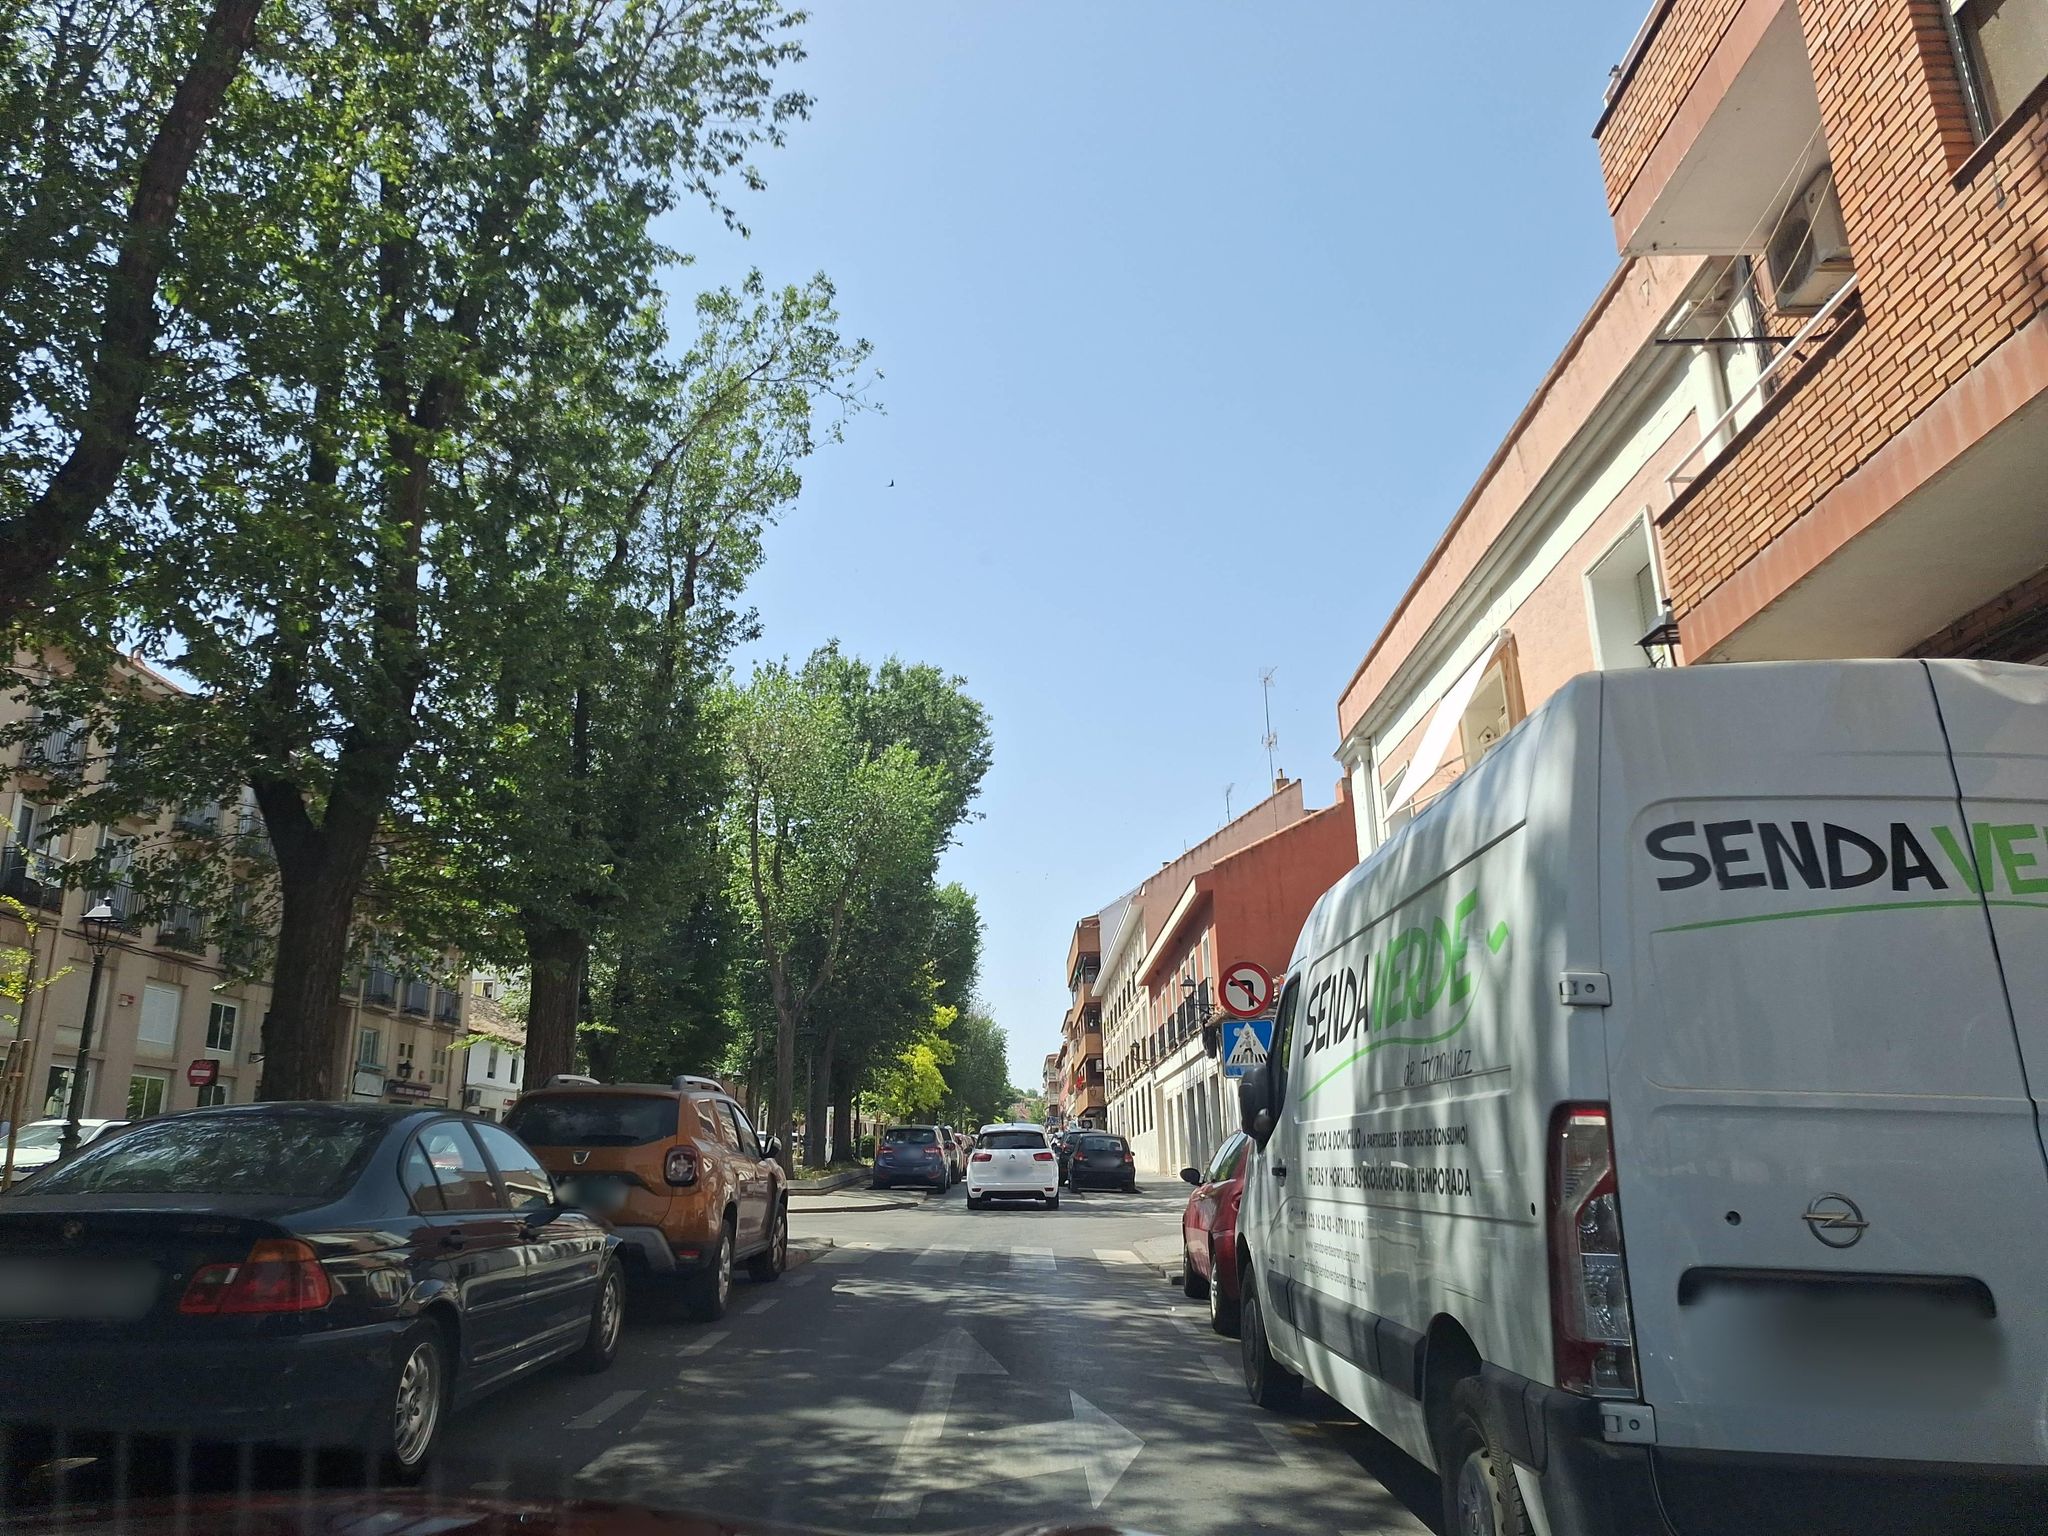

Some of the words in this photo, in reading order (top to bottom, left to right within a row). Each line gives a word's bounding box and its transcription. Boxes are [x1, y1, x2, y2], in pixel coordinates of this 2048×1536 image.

[1645, 819, 2048, 895] SENDAVE
[1303, 887, 1478, 1060] SENDAVERDE
[1403, 1047, 1415, 1087] de
[1419, 1047, 1473, 1098] Aranjuez
[1307, 1130, 1327, 1152] SERVICIO
[1332, 1128, 1361, 1150] DOMICILIO
[1366, 1131, 1397, 1149] PARTICULARES
[1403, 1128, 1424, 1147] GRUPOS
[1425, 1128, 1433, 1147] DE
[1329, 1166, 1362, 1189] HORTALIZAS
[1405, 1167, 1415, 1193] DE
[1416, 1167, 1472, 1197] TEMPORADA
